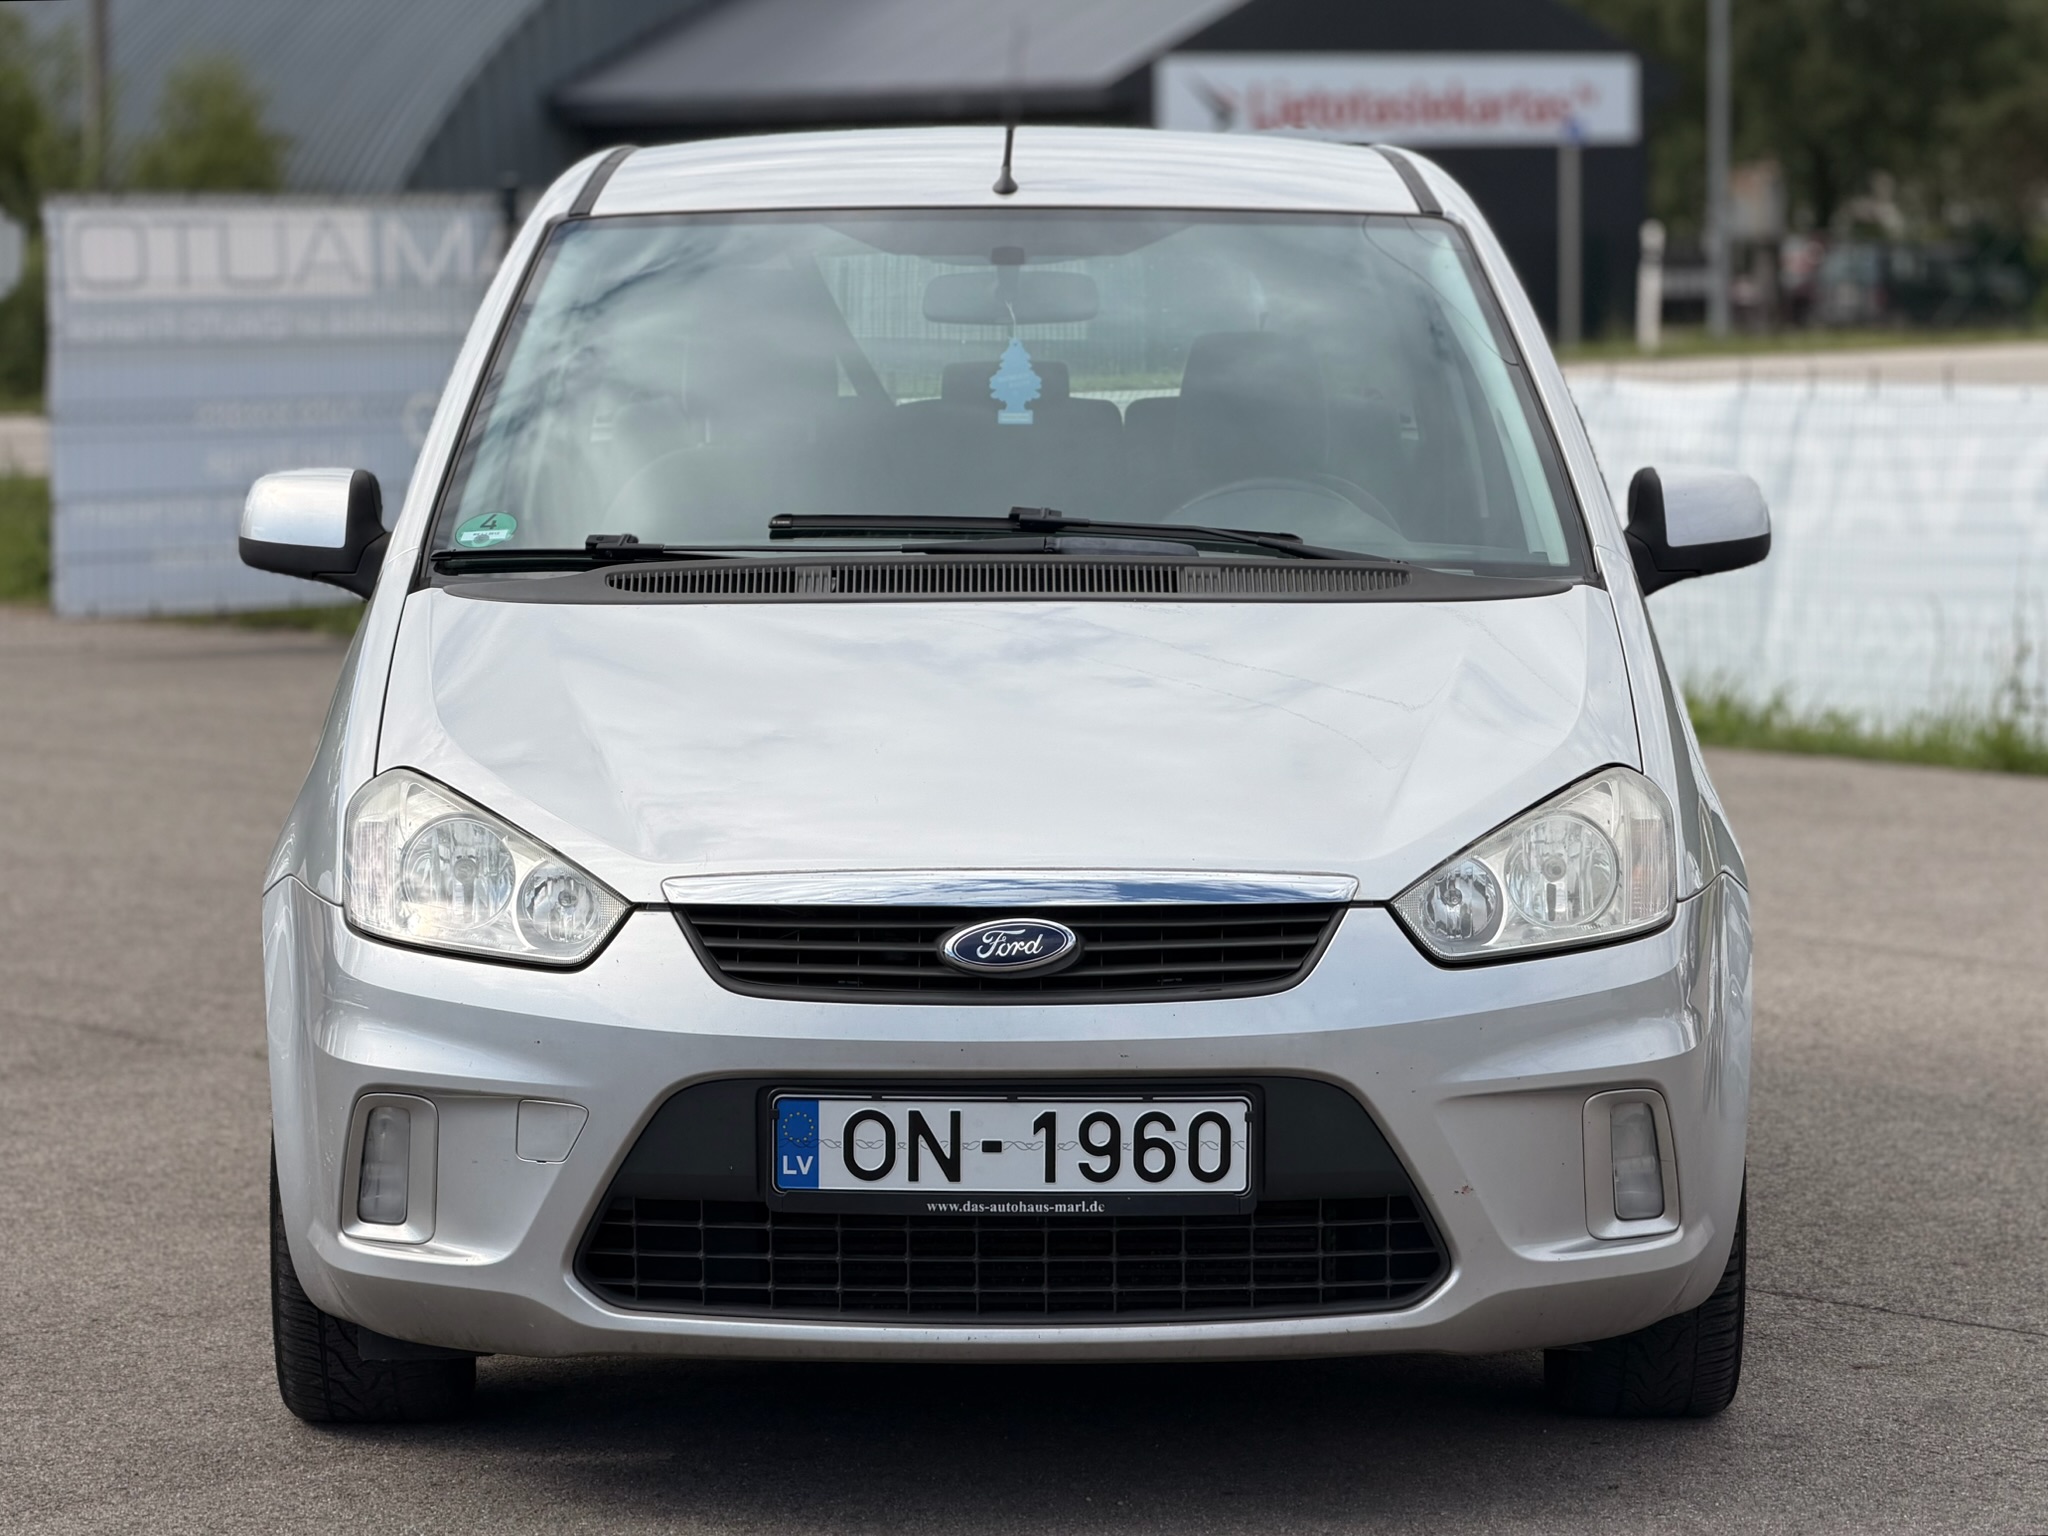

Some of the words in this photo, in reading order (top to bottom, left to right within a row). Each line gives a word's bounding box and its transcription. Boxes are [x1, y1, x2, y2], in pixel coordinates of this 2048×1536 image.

[480, 514, 497, 530] 4
[976, 929, 1044, 959] Ford
[842, 1107, 1232, 1184] ON-1960
[782, 1155, 814, 1176] LV
[926, 1200, 1106, 1215] www.das-autohaus-marl.de
